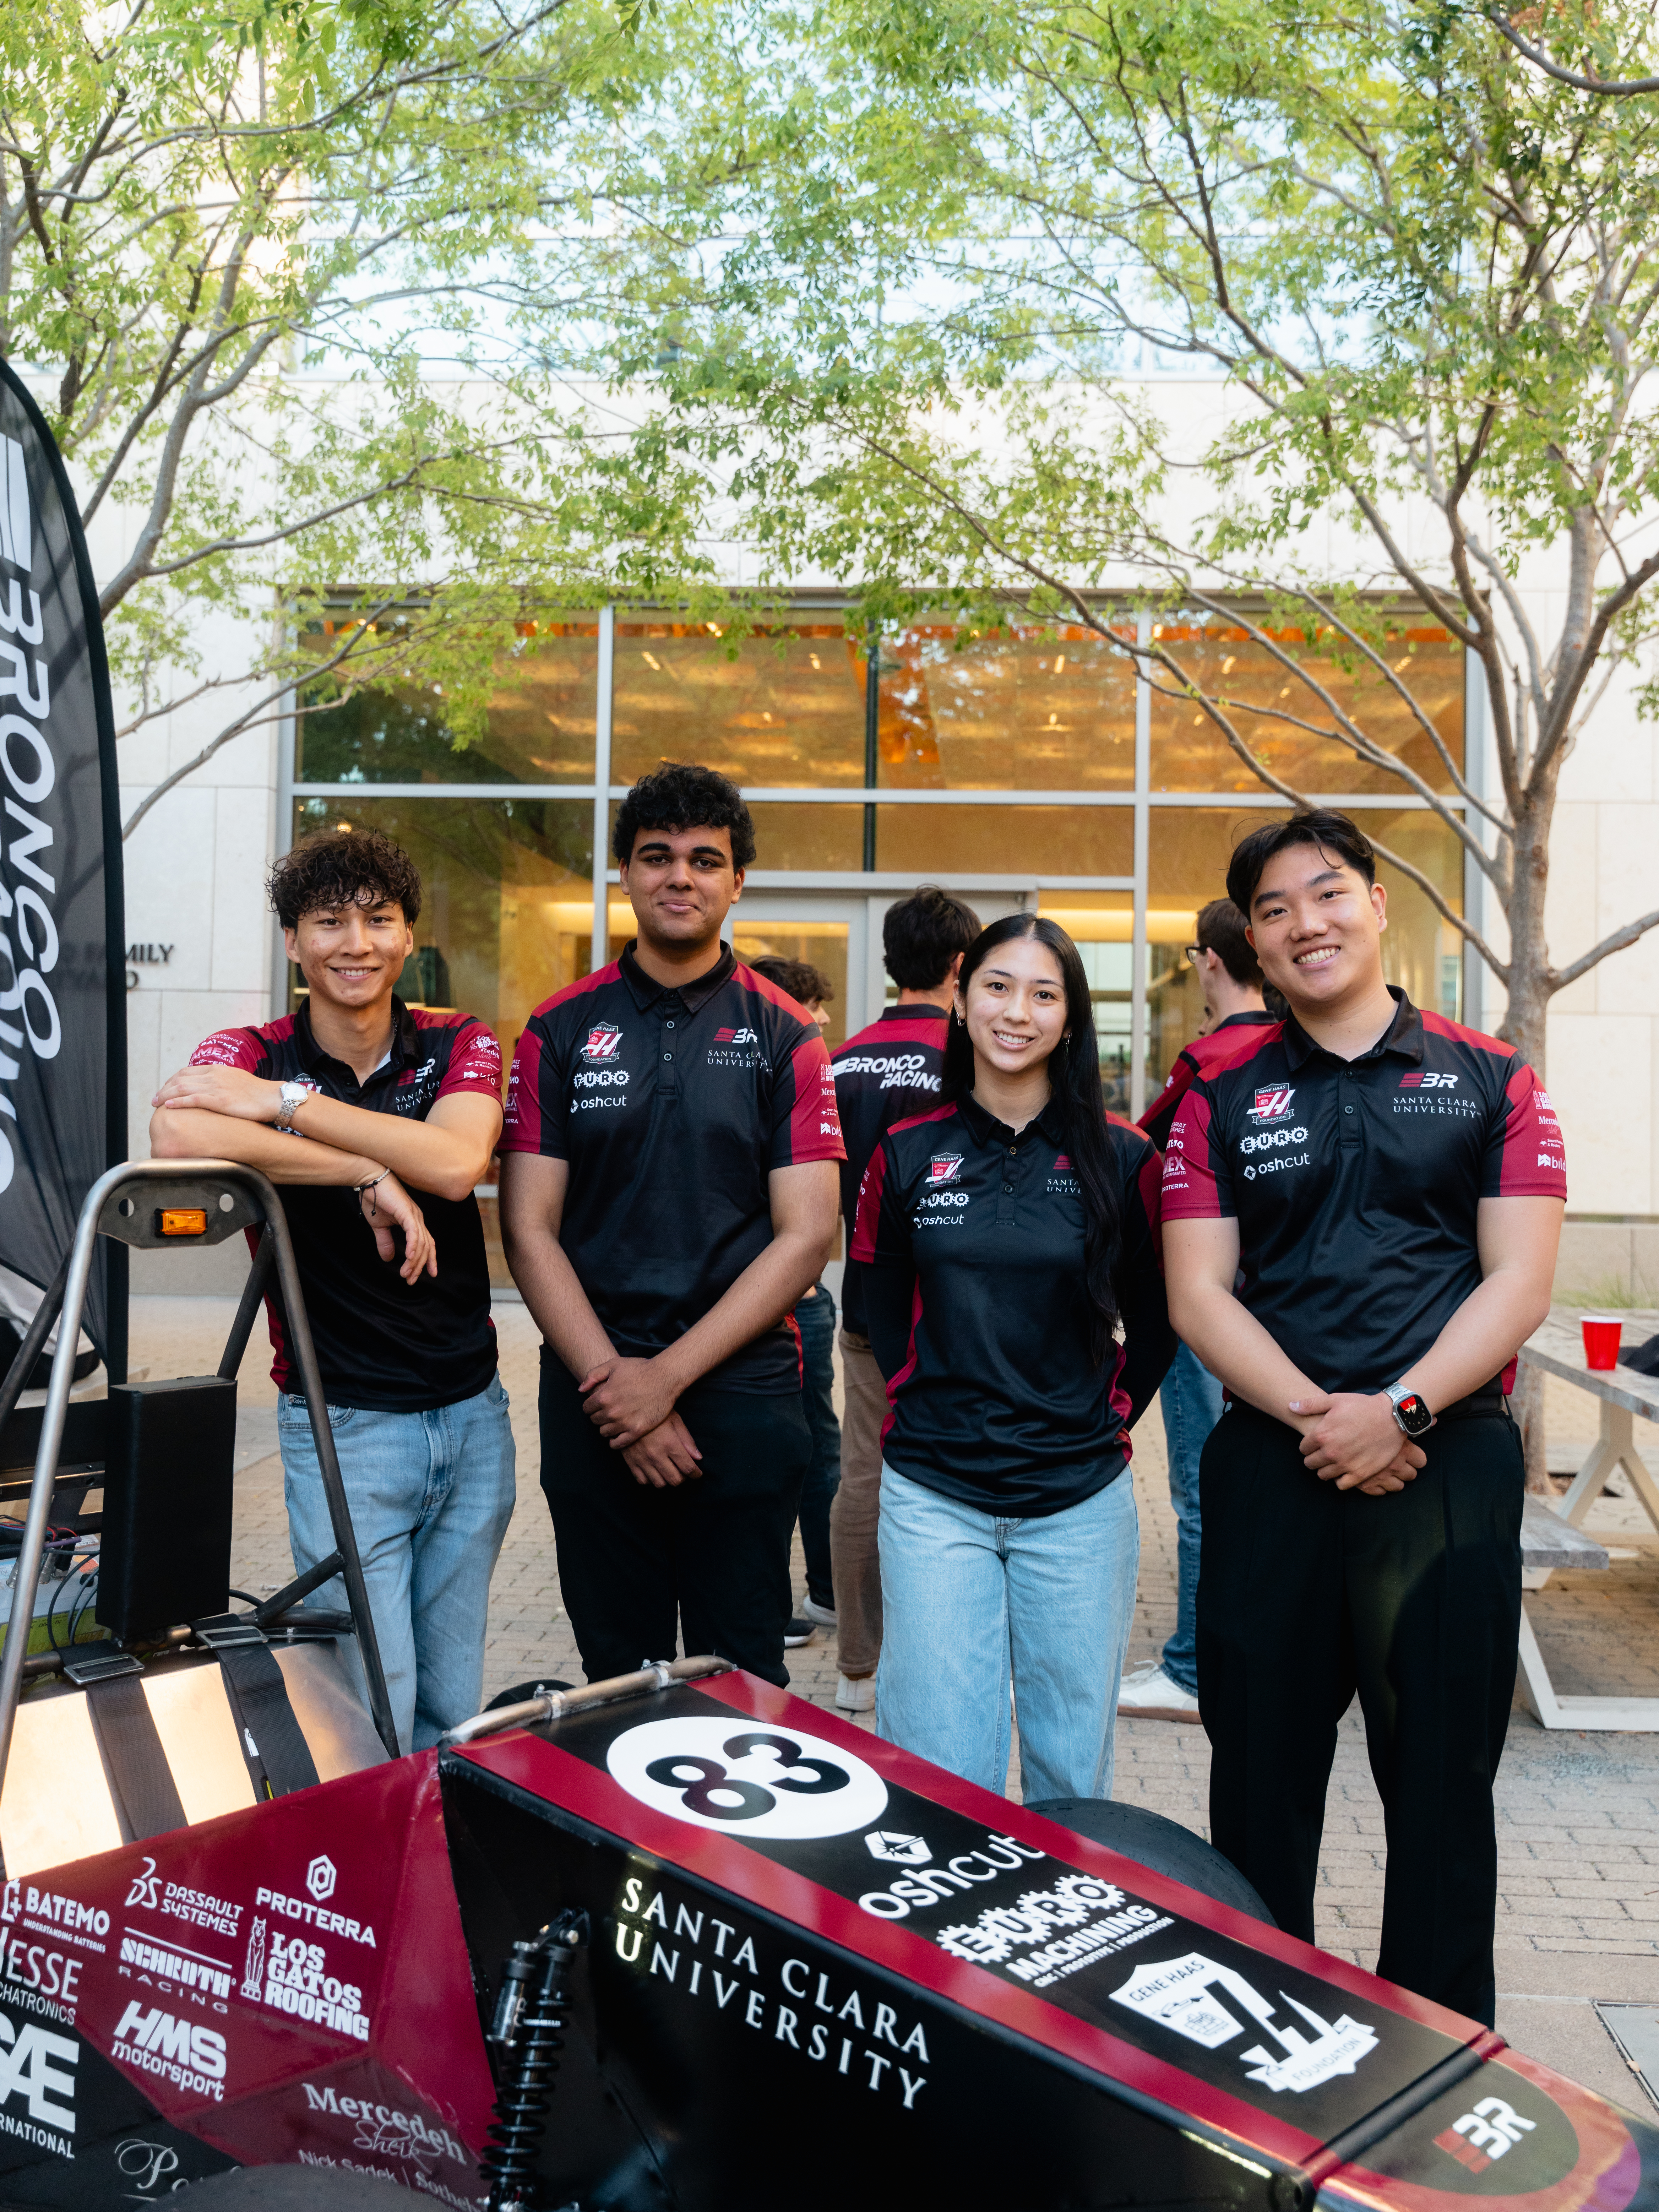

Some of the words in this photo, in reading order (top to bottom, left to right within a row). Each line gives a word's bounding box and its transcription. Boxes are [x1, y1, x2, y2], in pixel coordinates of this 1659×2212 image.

[0, 578, 61, 1060] BRONCO
[201, 1039, 239, 1053] BATMO
[481, 1048, 499, 1059] rcedeh
[708, 1050, 741, 1058] SANTA
[746, 1051, 768, 1066] CLAA
[845, 1054, 926, 1074] BRONCO
[581, 1095, 627, 1109] oshcut
[880, 1070, 942, 1092] RACING
[1420, 1072, 1458, 1089] BR
[1437, 1097, 1476, 1109] CLARA
[1242, 1128, 1307, 1152] EURO
[1259, 1115, 1286, 1123] FOUNDATION
[1258, 1153, 1310, 1174] oshcut
[922, 1214, 964, 1225] oshcut
[646, 1733, 851, 1820] 83
[859, 1834, 1046, 1919] oshcut
[25, 1886, 110, 1936] BATEMO
[161, 1898, 238, 1936] SYSTEMES
[165, 1882, 244, 1919] DASSAULT
[256, 1886, 376, 1948] PROTERRA
[946, 1882, 1117, 1958] EURO
[23, 1918, 73, 1942] UNDERSTANDING
[74, 1935, 106, 1953] BATTERIES
[271, 1931, 325, 1972] LOS
[1005, 1904, 1158, 1982] MACHINING
[1034, 1973, 1059, 1988] CNC
[1060, 1945, 1115, 1975] PROTOTYPE
[1115, 1916, 1175, 1947] PRODUCTION
[119, 1965, 228, 2013] RACING
[121, 1937, 232, 1999] SCHROTH
[267, 1956, 361, 2013] GATOS
[622, 1878, 759, 1975] SANTA
[781, 1959, 930, 2063] CLARA
[1128, 1977, 1170, 2003] GENE
[1169, 1960, 1206, 1981] HAAS
[264, 1979, 370, 2042] ROOFING
[615, 1922, 927, 2109] UNIVERSITY
[112, 2000, 227, 2079] HMS
[1293, 2037, 1362, 2082] FOUNDATION
[111, 2039, 225, 2102] motorsport
[302, 2083, 467, 2165] Mercedeh
